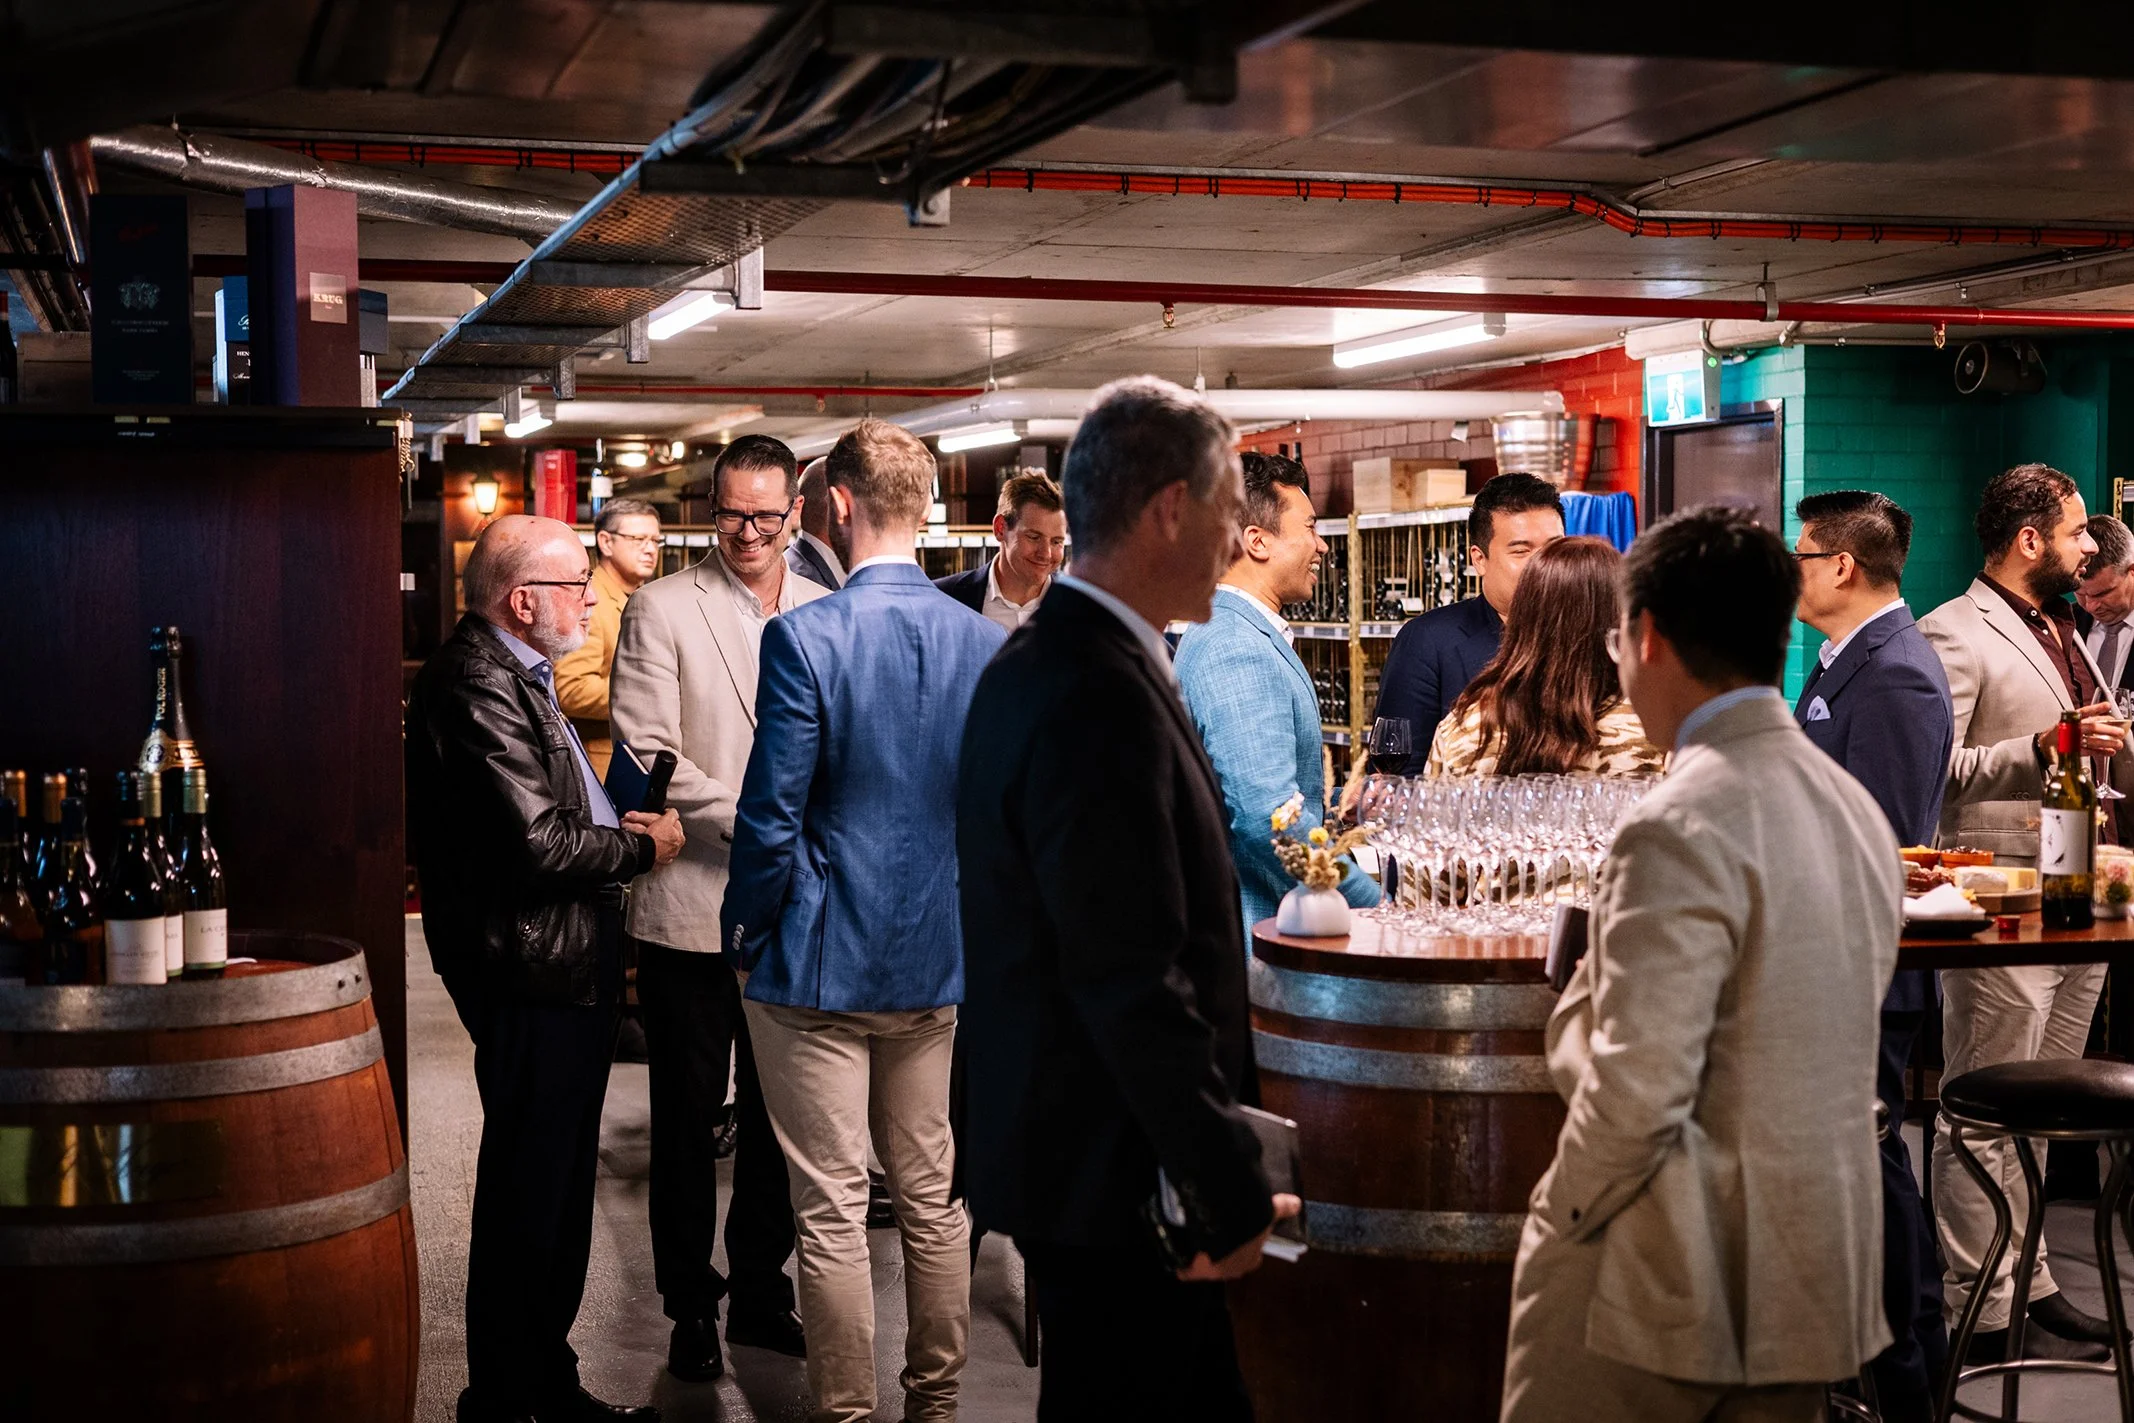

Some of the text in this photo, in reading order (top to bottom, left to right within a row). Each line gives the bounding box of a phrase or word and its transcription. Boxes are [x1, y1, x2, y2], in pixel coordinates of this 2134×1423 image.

[312, 292, 344, 305] KRUG
[155, 667, 167, 721] POL ROGER
